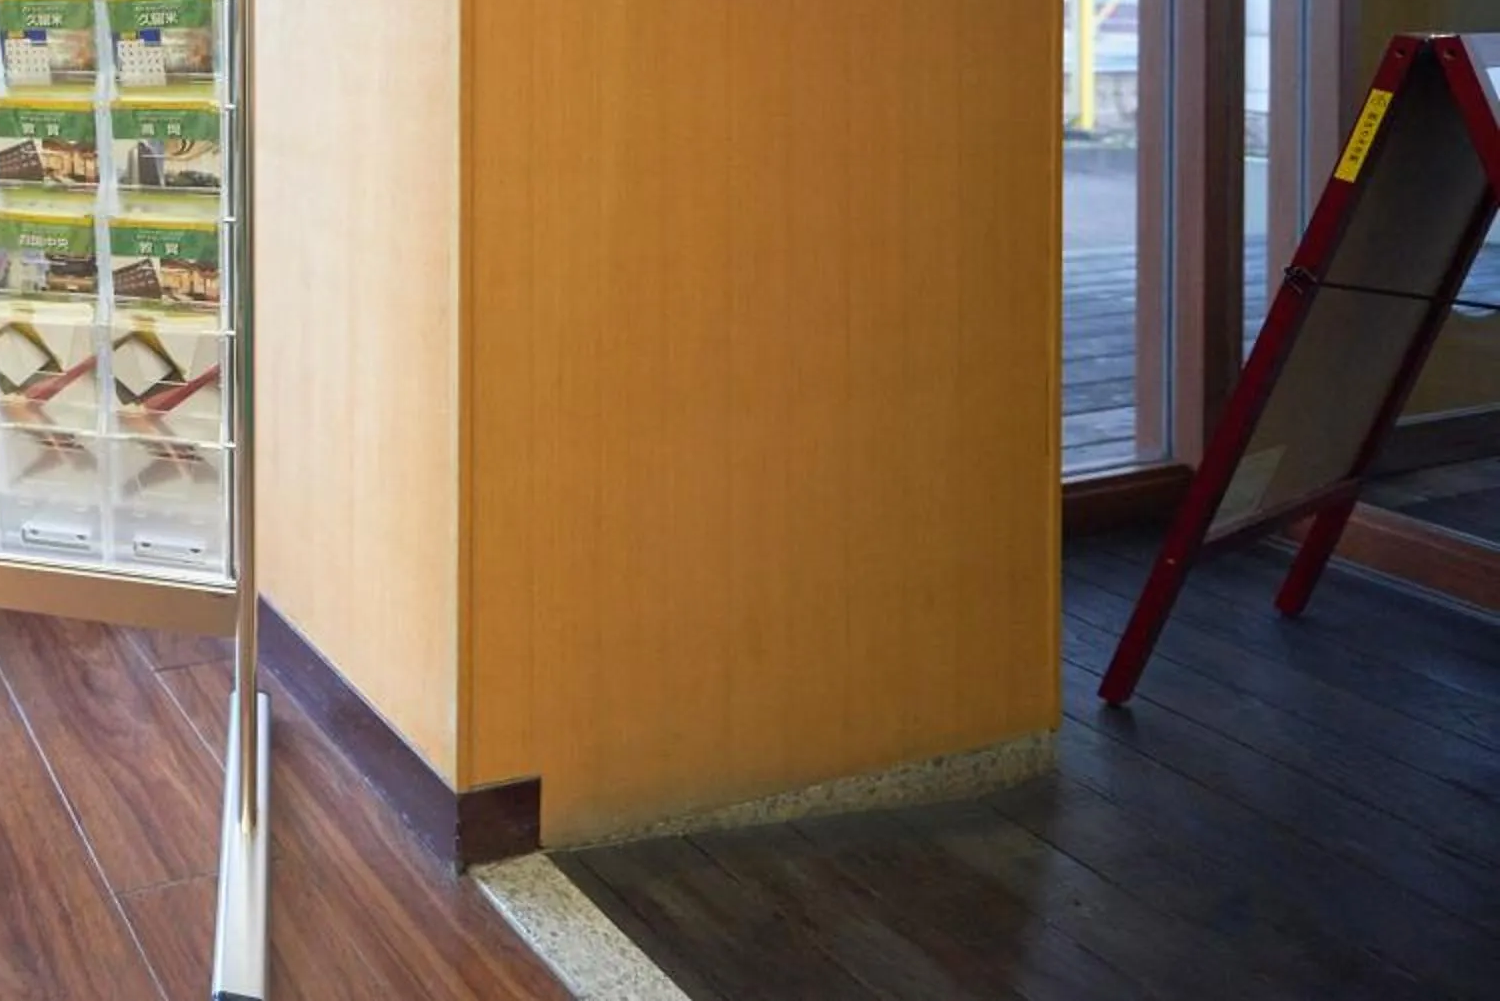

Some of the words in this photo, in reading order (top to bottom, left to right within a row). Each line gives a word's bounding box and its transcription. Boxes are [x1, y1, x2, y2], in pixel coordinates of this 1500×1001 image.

[26, 13, 63, 27] 久留米
[137, 11, 179, 27] 久留米
